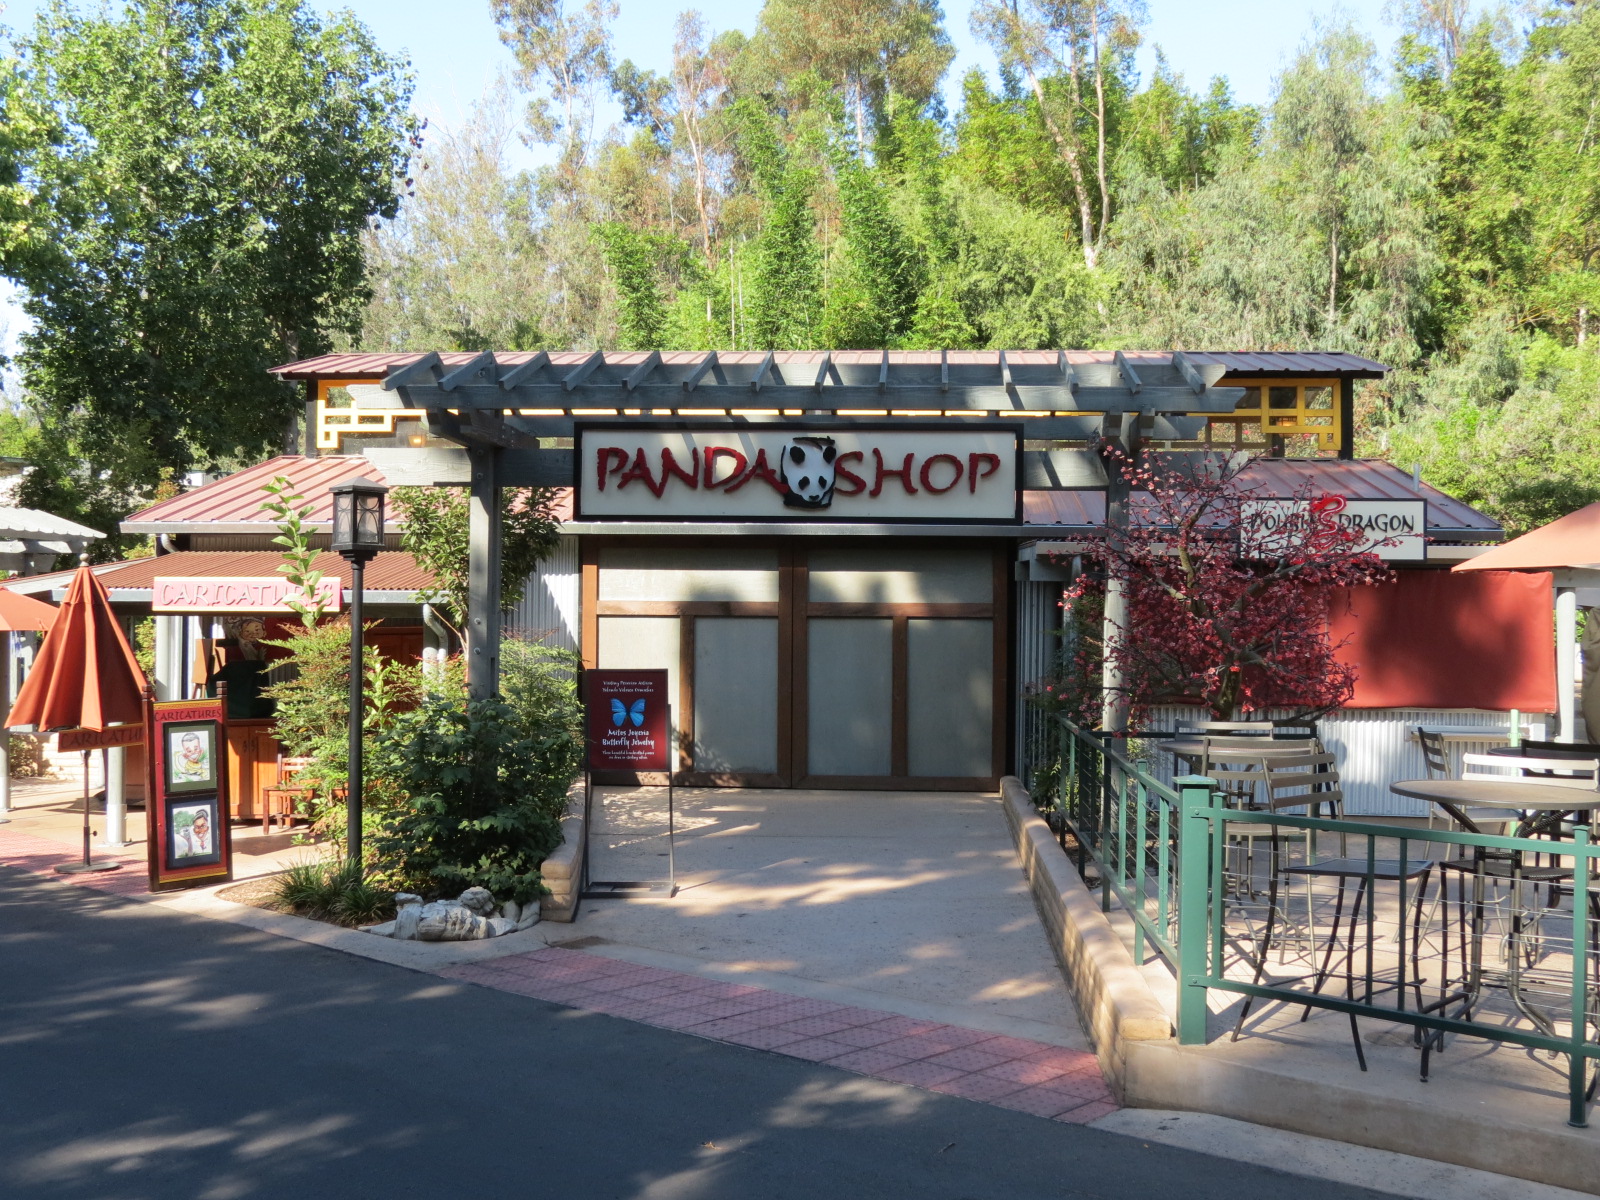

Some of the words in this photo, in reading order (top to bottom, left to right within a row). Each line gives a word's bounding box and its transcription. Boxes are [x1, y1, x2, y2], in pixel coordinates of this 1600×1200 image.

[597, 445, 789, 499] PANDA
[834, 446, 1001, 497] SHOP
[1338, 513, 1415, 533] DRAGON
[154, 708, 222, 722] CARICATURES
[602, 736, 630, 750] Butterfly
[631, 736, 655, 750] Jewelry
